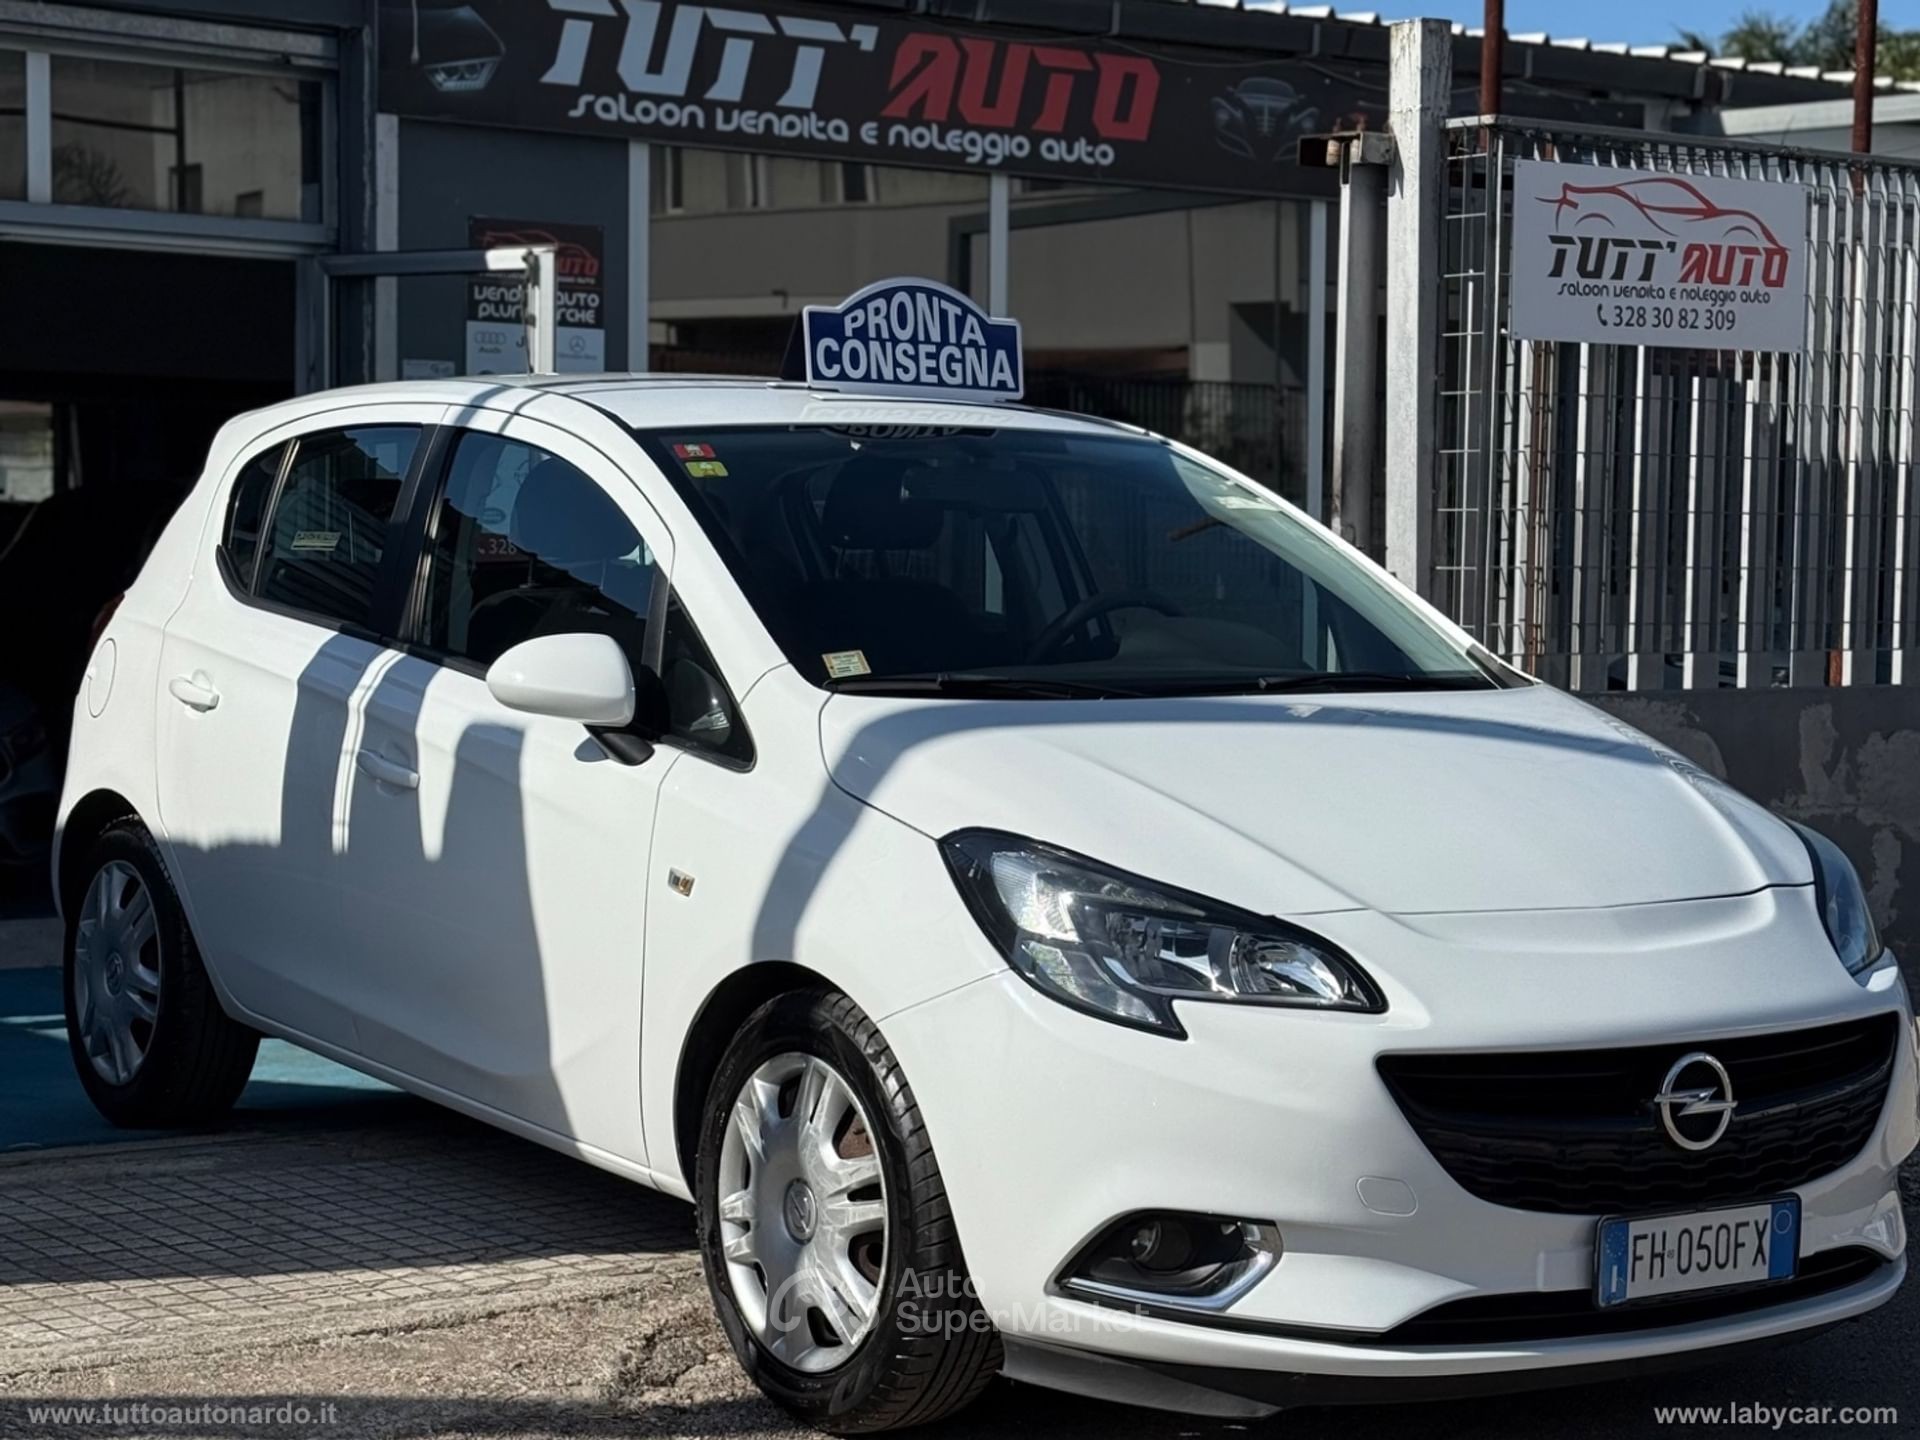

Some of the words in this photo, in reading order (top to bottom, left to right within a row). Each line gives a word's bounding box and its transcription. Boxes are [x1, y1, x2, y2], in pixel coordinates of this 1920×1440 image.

[1040, 136, 1114, 166] auto
[844, 291, 986, 346] PRONTA
[1613, 305, 1647, 327] 328
[1652, 307, 1673, 328] 30
[1678, 308, 1699, 330] 82
[1704, 309, 1736, 330] 309
[815, 337, 1016, 389] CONSEGNA
